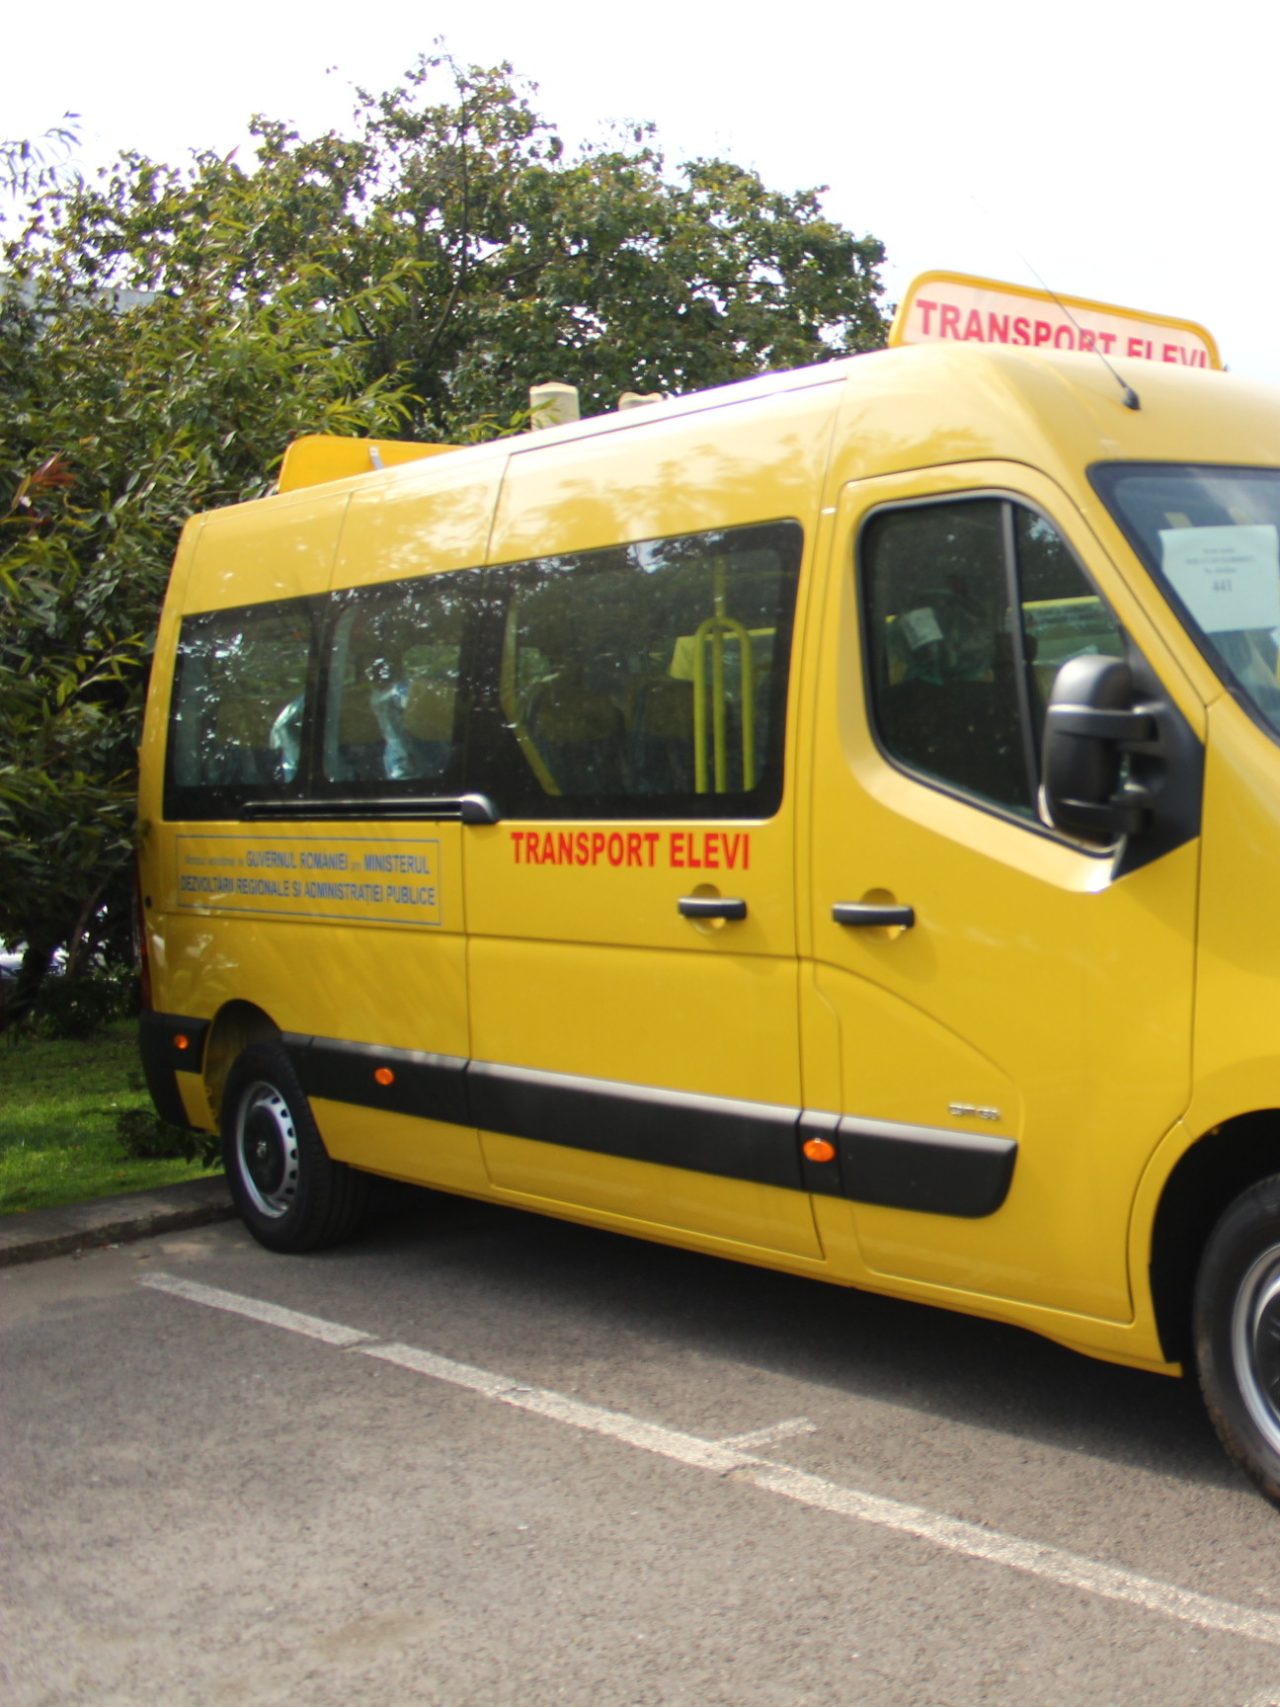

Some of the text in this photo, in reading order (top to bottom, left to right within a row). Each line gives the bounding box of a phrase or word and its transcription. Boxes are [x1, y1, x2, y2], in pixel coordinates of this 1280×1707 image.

[916, 299, 1206, 369] TRANSPORT ELEVI
[246, 851, 297, 868] GUVERNUL
[364, 854, 431, 874] MINISTERUL
[511, 831, 750, 870] TRANSPORT ELEVI
[236, 878, 290, 897] REGIONALE
[386, 885, 436, 906] PUBLICE
